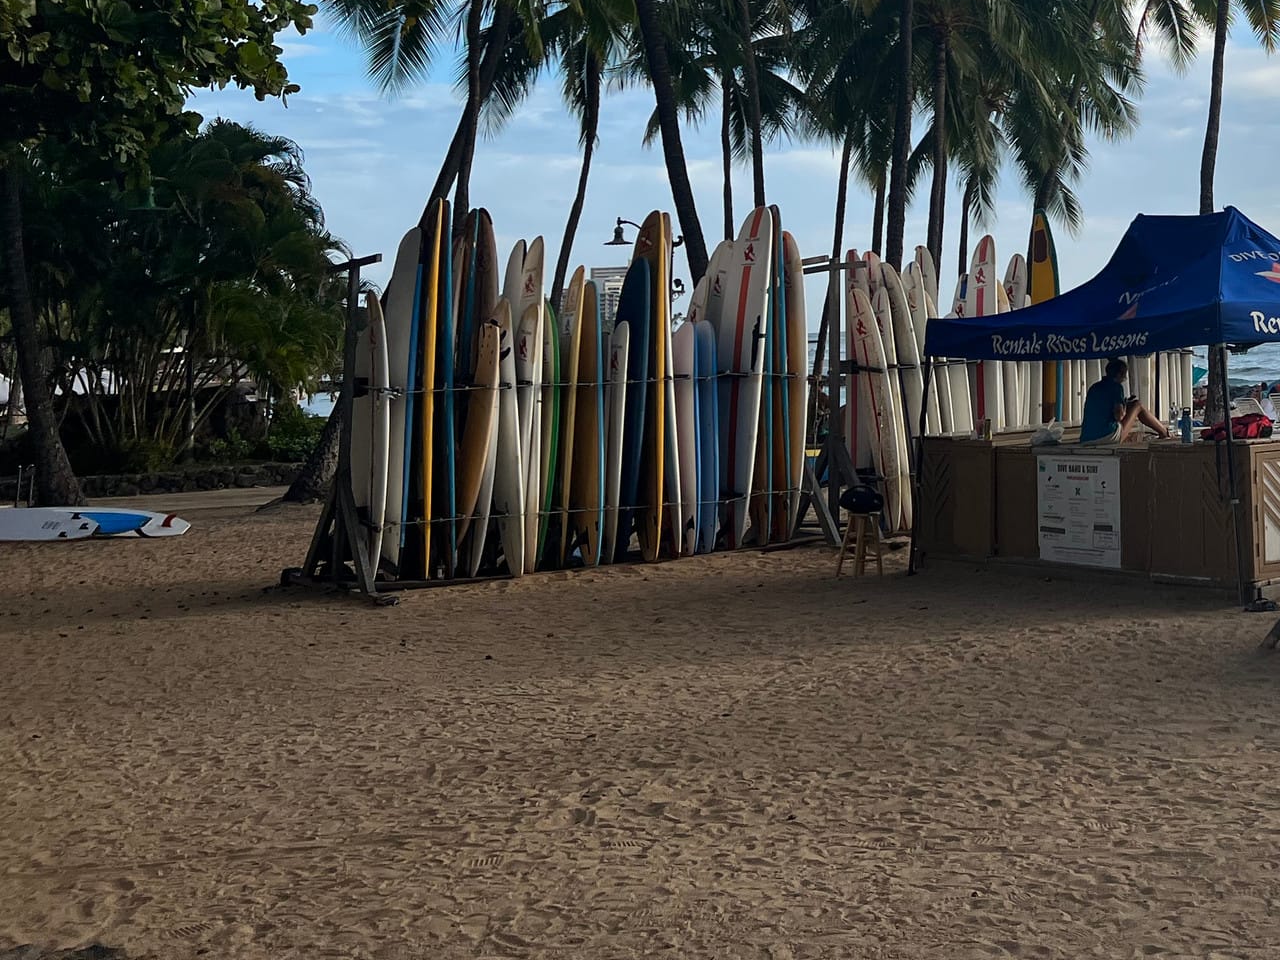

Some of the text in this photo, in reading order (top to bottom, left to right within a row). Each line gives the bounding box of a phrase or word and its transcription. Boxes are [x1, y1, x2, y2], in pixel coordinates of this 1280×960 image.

[1228, 250, 1268, 262] DIVE
[991, 331, 1149, 354] Rentals Rides Lessons
